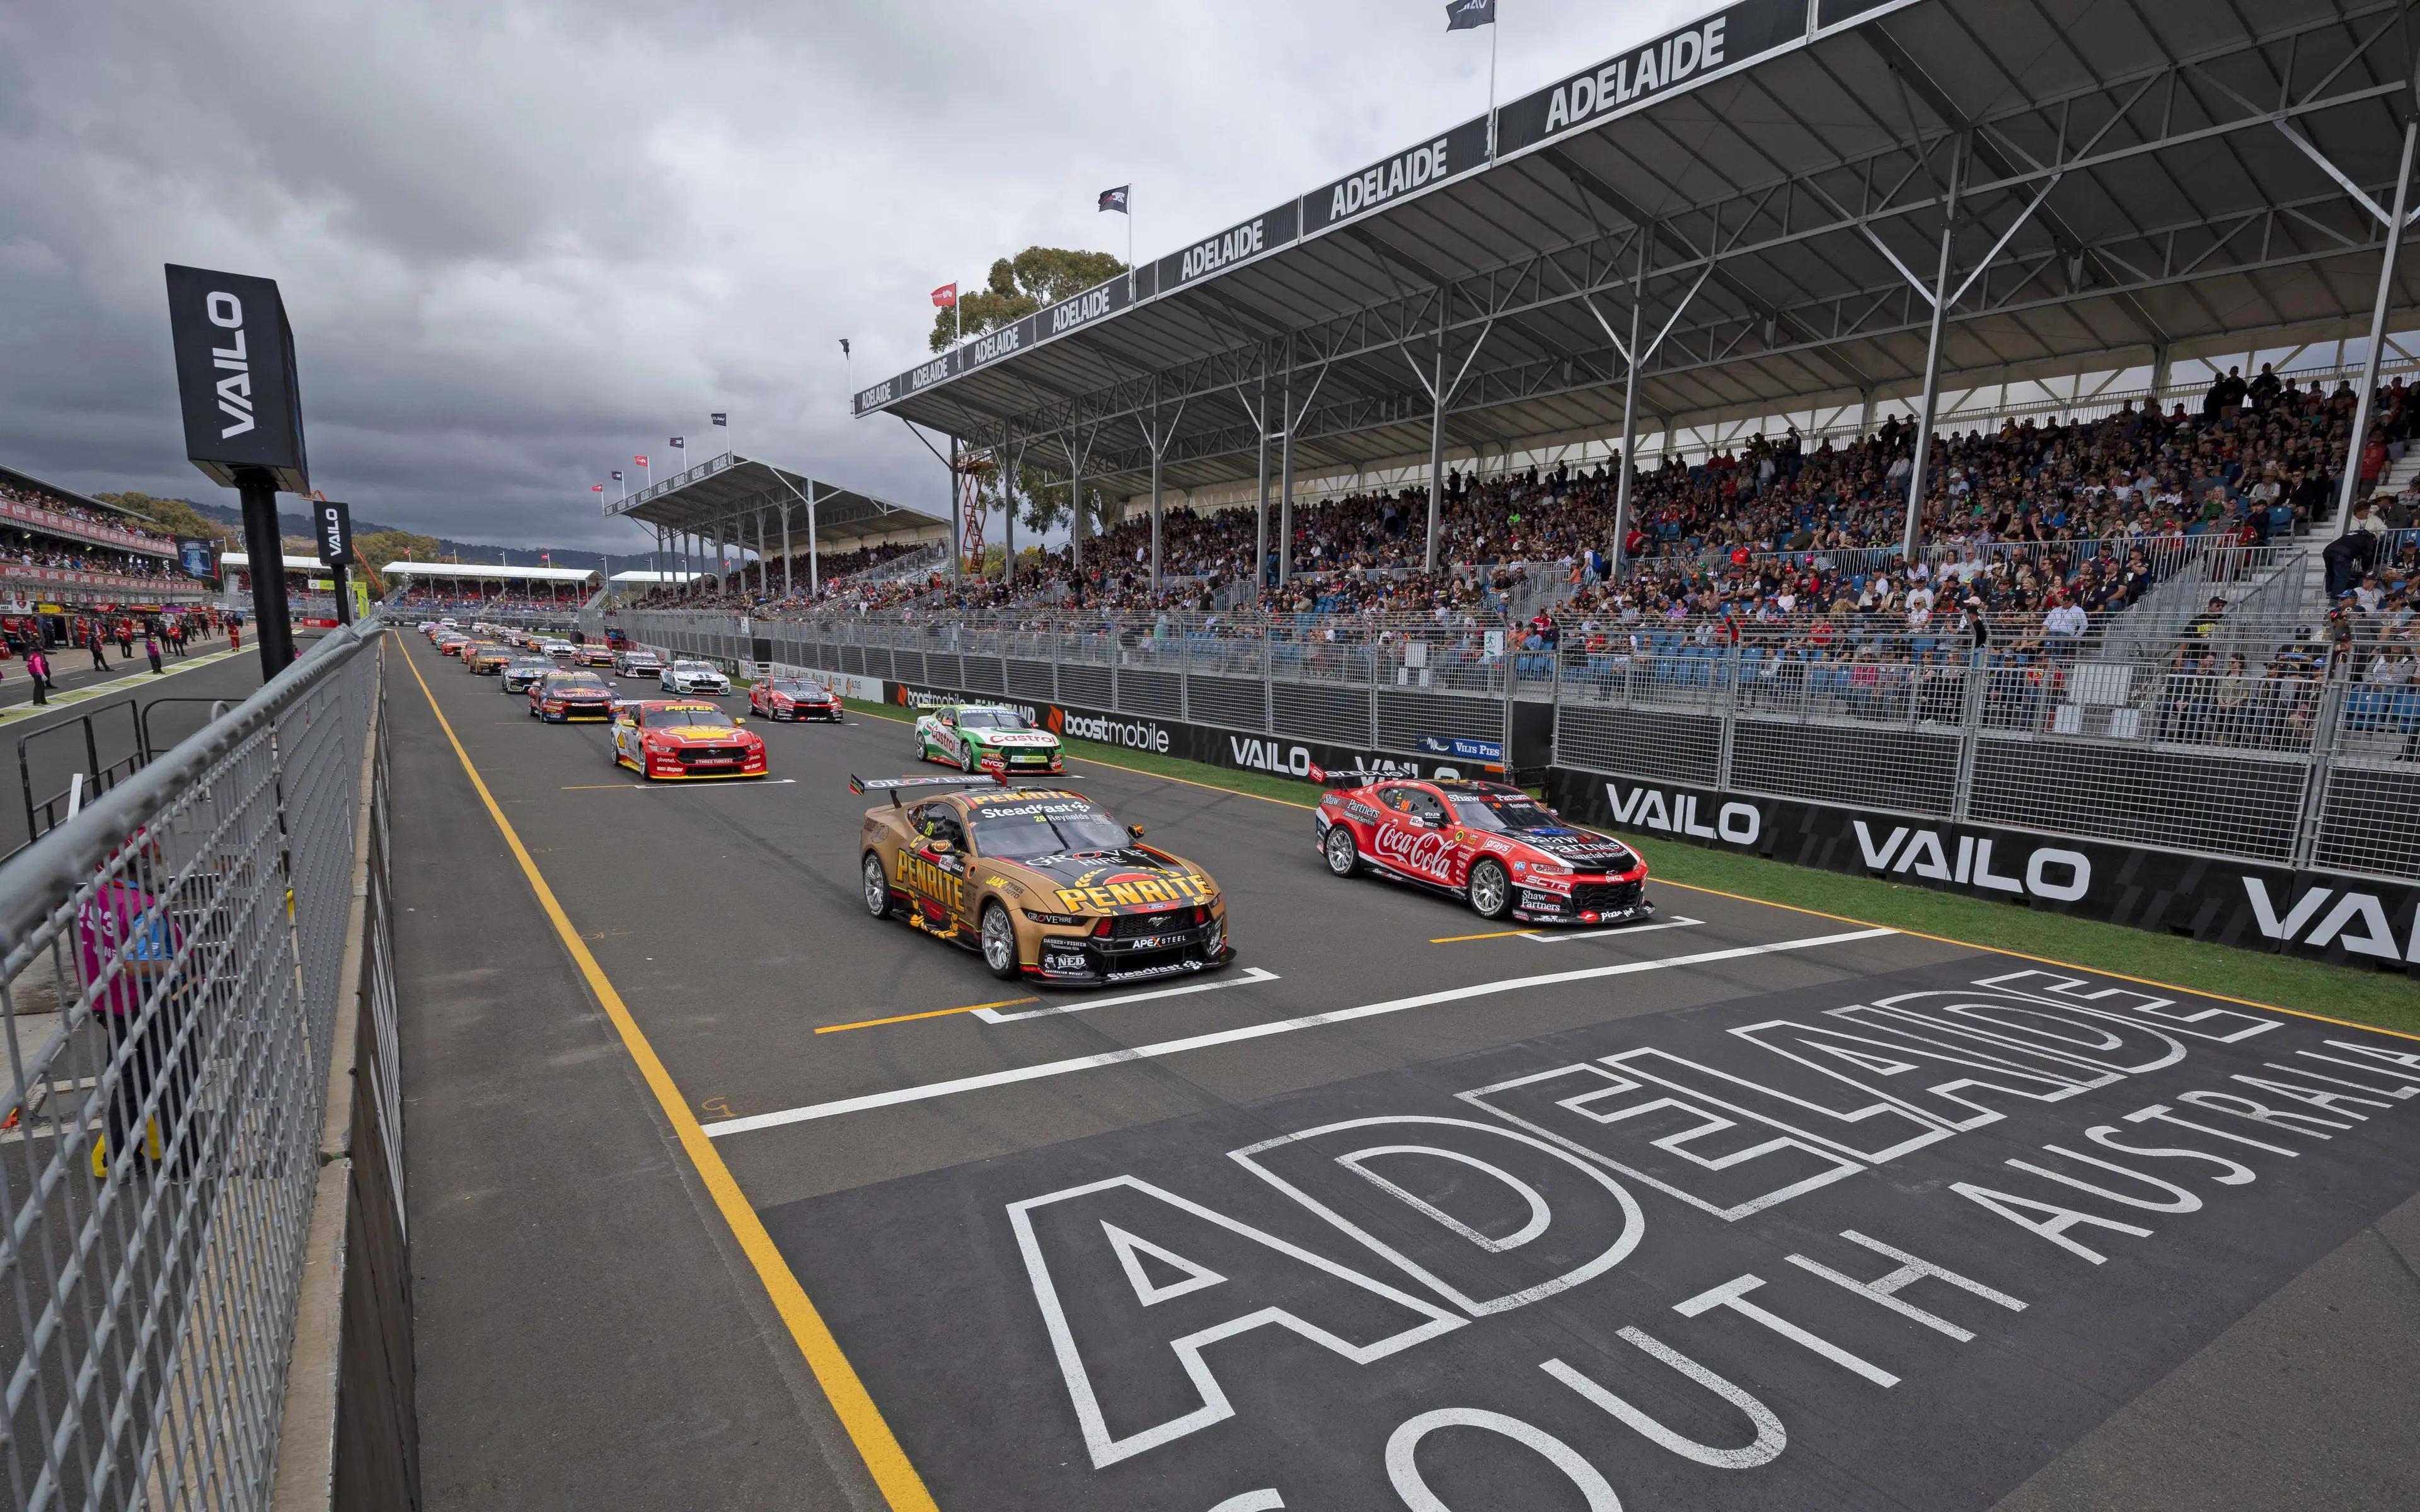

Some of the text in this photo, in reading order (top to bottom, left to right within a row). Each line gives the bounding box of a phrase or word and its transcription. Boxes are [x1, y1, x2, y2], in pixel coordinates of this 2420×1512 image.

[1545, 16, 1726, 133] ADELAIDE
[1330, 138, 1448, 220] ADELAIDE
[1181, 219, 1264, 280] ADELAIDE
[1052, 287, 1110, 333] ADELAIDE
[974, 326, 1019, 365] ADELAIDE
[206, 290, 255, 439] VAILO
[913, 358, 947, 390] ADELAIDE
[861, 382, 891, 410] ADELAIDE
[712, 455, 727, 472] ADELAIDE
[692, 466, 705, 479] ADELAIDE
[325, 508, 343, 557] VAILO
[833, 677, 841, 687] ALTUS
[851, 680, 861, 690] ALTUS
[931, 725, 955, 753] Castrol
[990, 733, 1057, 745] Castrol
[1064, 710, 1169, 753] boostmobile
[1230, 735, 1311, 777] VAILO
[1479, 745, 1500, 757] PIES
[981, 759, 1005, 767] RYCO
[1051, 759, 1063, 767] RYCO
[867, 774, 992, 788] GROVE HIRE
[971, 791, 1076, 805] PENRITE
[1400, 799, 1410, 811] 99
[1448, 794, 1480, 802] Shaw
[1494, 793, 1531, 801] Partners
[981, 803, 1074, 818] Steadfast
[1323, 794, 1340, 805] Shaw
[1347, 799, 1380, 819] Partners
[1606, 782, 1761, 845] VAILO
[1047, 813, 1090, 822] Reynolds
[1343, 811, 1375, 827] Financial Services
[924, 821, 935, 837] 26
[1486, 839, 1510, 852] grays
[1514, 834, 1579, 844] Shaw
[1375, 819, 1460, 879] Coca-Cola
[1543, 842, 1620, 853] Partners
[1552, 849, 1629, 860] Financial Services
[1025, 849, 1148, 867] GROVE
[1077, 856, 1127, 867] HIRE
[1852, 820, 2092, 902] VAILO
[952, 862, 964, 873] VAILO
[1473, 860, 1492, 874] DUNLOP
[1543, 865, 1565, 874] PEDDERS
[896, 849, 965, 914] PENRITE
[985, 875, 1008, 888] JAX
[1008, 881, 1025, 894] TYRES
[1524, 874, 1572, 891] SCTR
[1056, 873, 1214, 913] PENRITE
[1522, 890, 1562, 903] Shaw and
[1521, 898, 1560, 912] Partners
[1028, 912, 1058, 924] GROVE
[1601, 907, 1635, 922] Pizza Hut
[1132, 935, 1187, 949] APEX STEEL
[1057, 956, 1085, 967] NED
[1107, 964, 1184, 980] Steadfast
[1947, 1039, 2420, 1266] AUSTRALIA
[1006, 968, 2285, 1470] ADELAIDE
